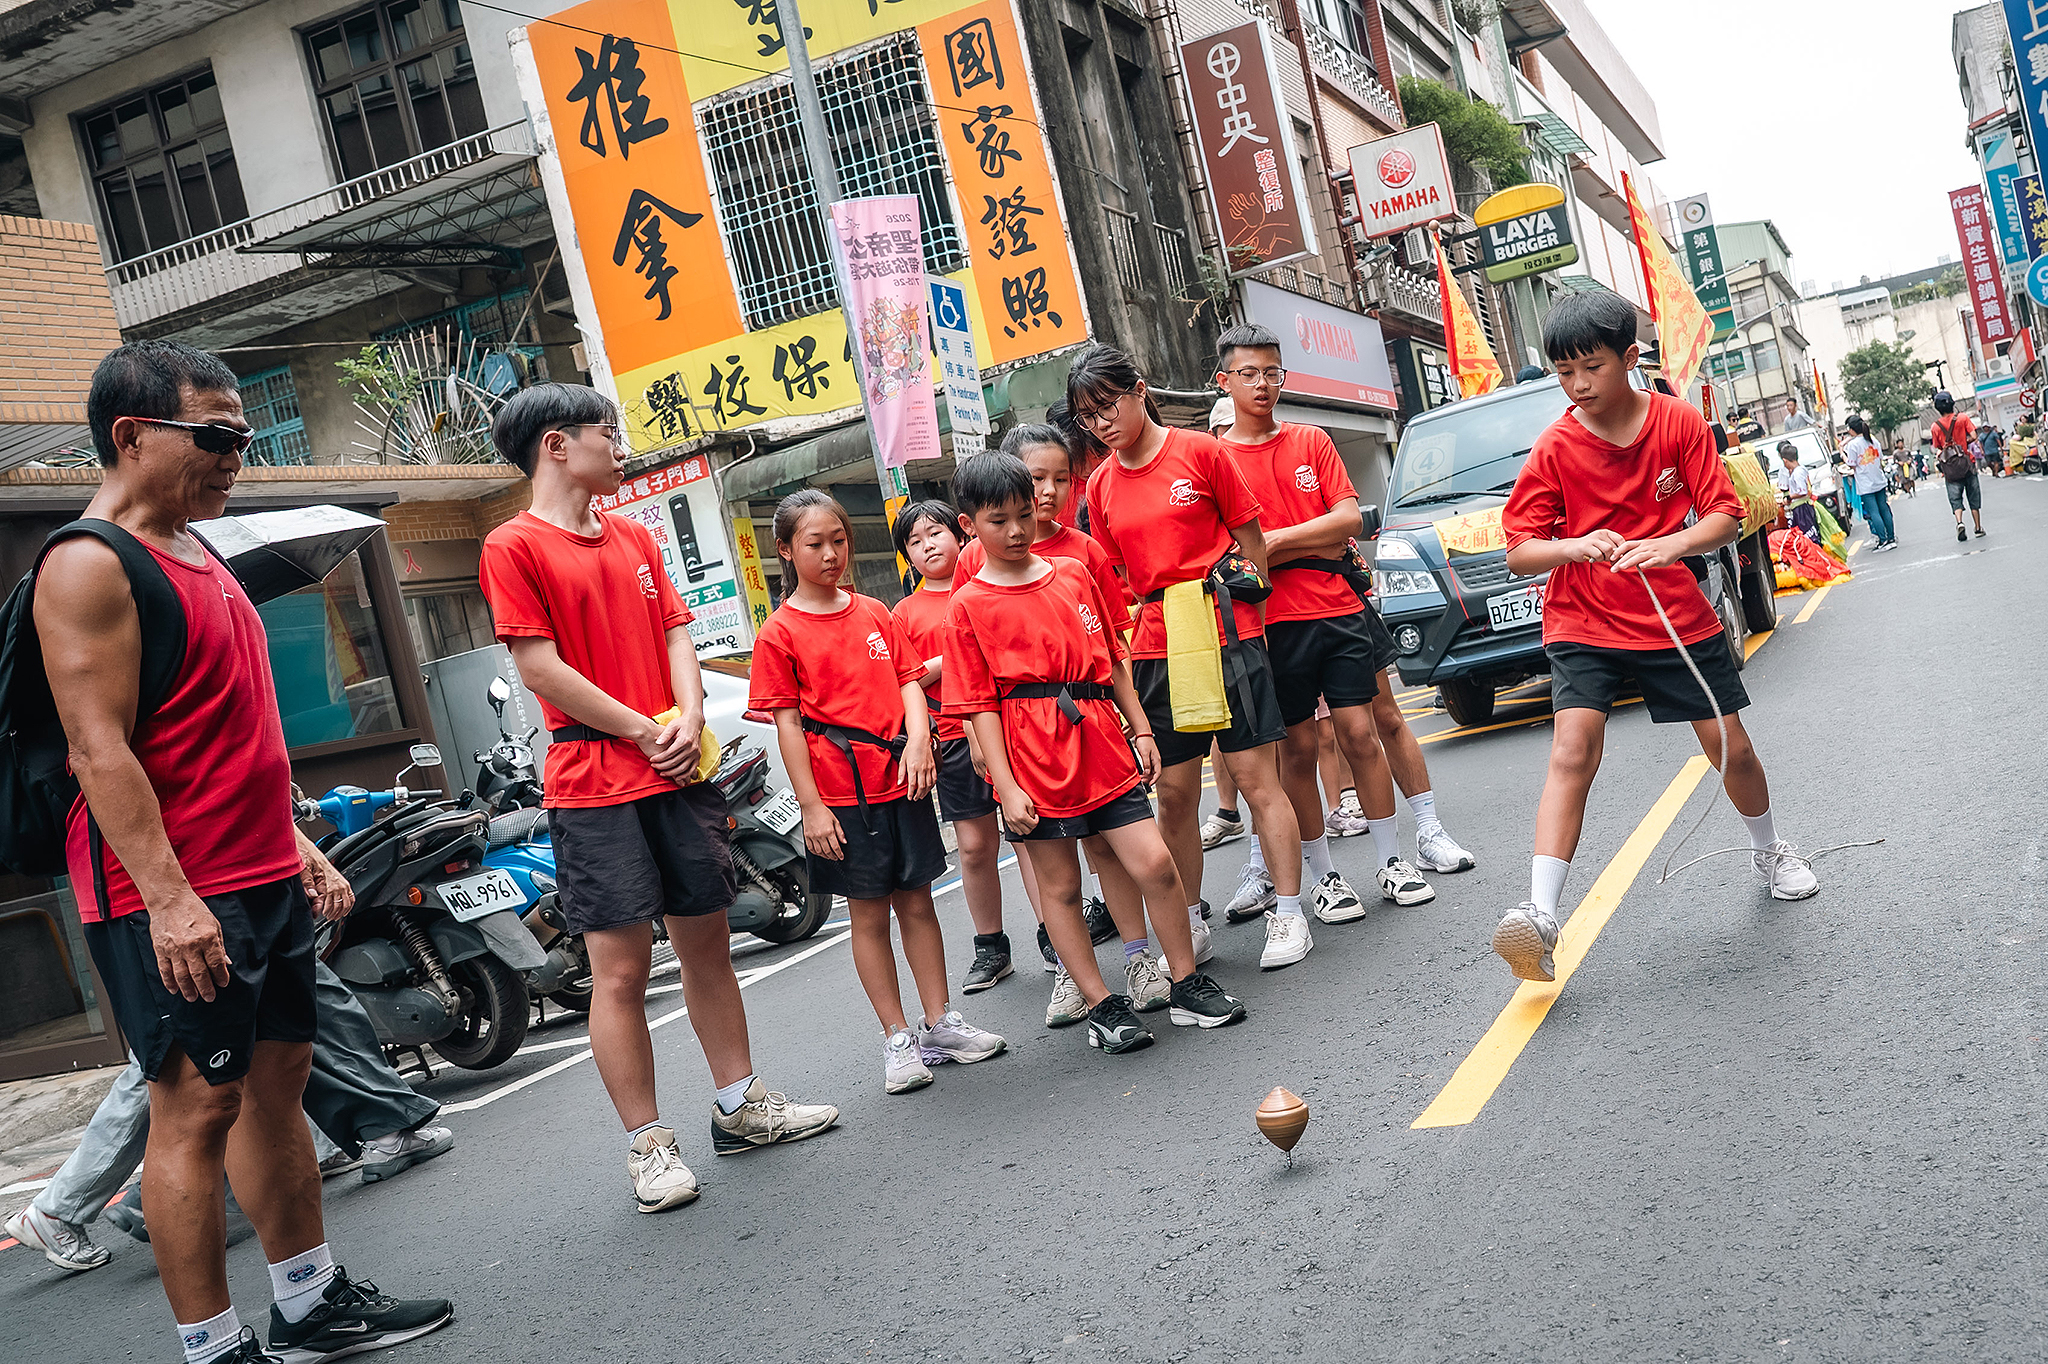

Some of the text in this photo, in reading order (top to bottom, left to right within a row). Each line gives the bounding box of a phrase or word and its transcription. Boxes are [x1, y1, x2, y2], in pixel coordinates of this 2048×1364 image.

[566, 33, 704, 321] 推拿
[943, 17, 1063, 340] 國家證照
[1254, 149, 1284, 214] 整復所
[1369, 185, 1440, 219] YAMAHA
[1998, 174, 2020, 233] DAIKIN
[1489, 211, 1556, 247] LAYA
[1494, 232, 1559, 262] BURGER
[1523, 253, 1562, 270] 拉亞漢堡
[1693, 232, 1717, 290] 第一銀行
[1960, 206, 2005, 338] 新資生連鎖藥局
[940, 336, 972, 358] 專用
[1308, 318, 1359, 363] YAMAHA
[643, 335, 860, 441] 醫校保
[945, 360, 976, 381] 停車位
[1419, 451, 1435, 470] 4
[403, 549, 421, 574] 入
[682, 585, 723, 606] 方式
